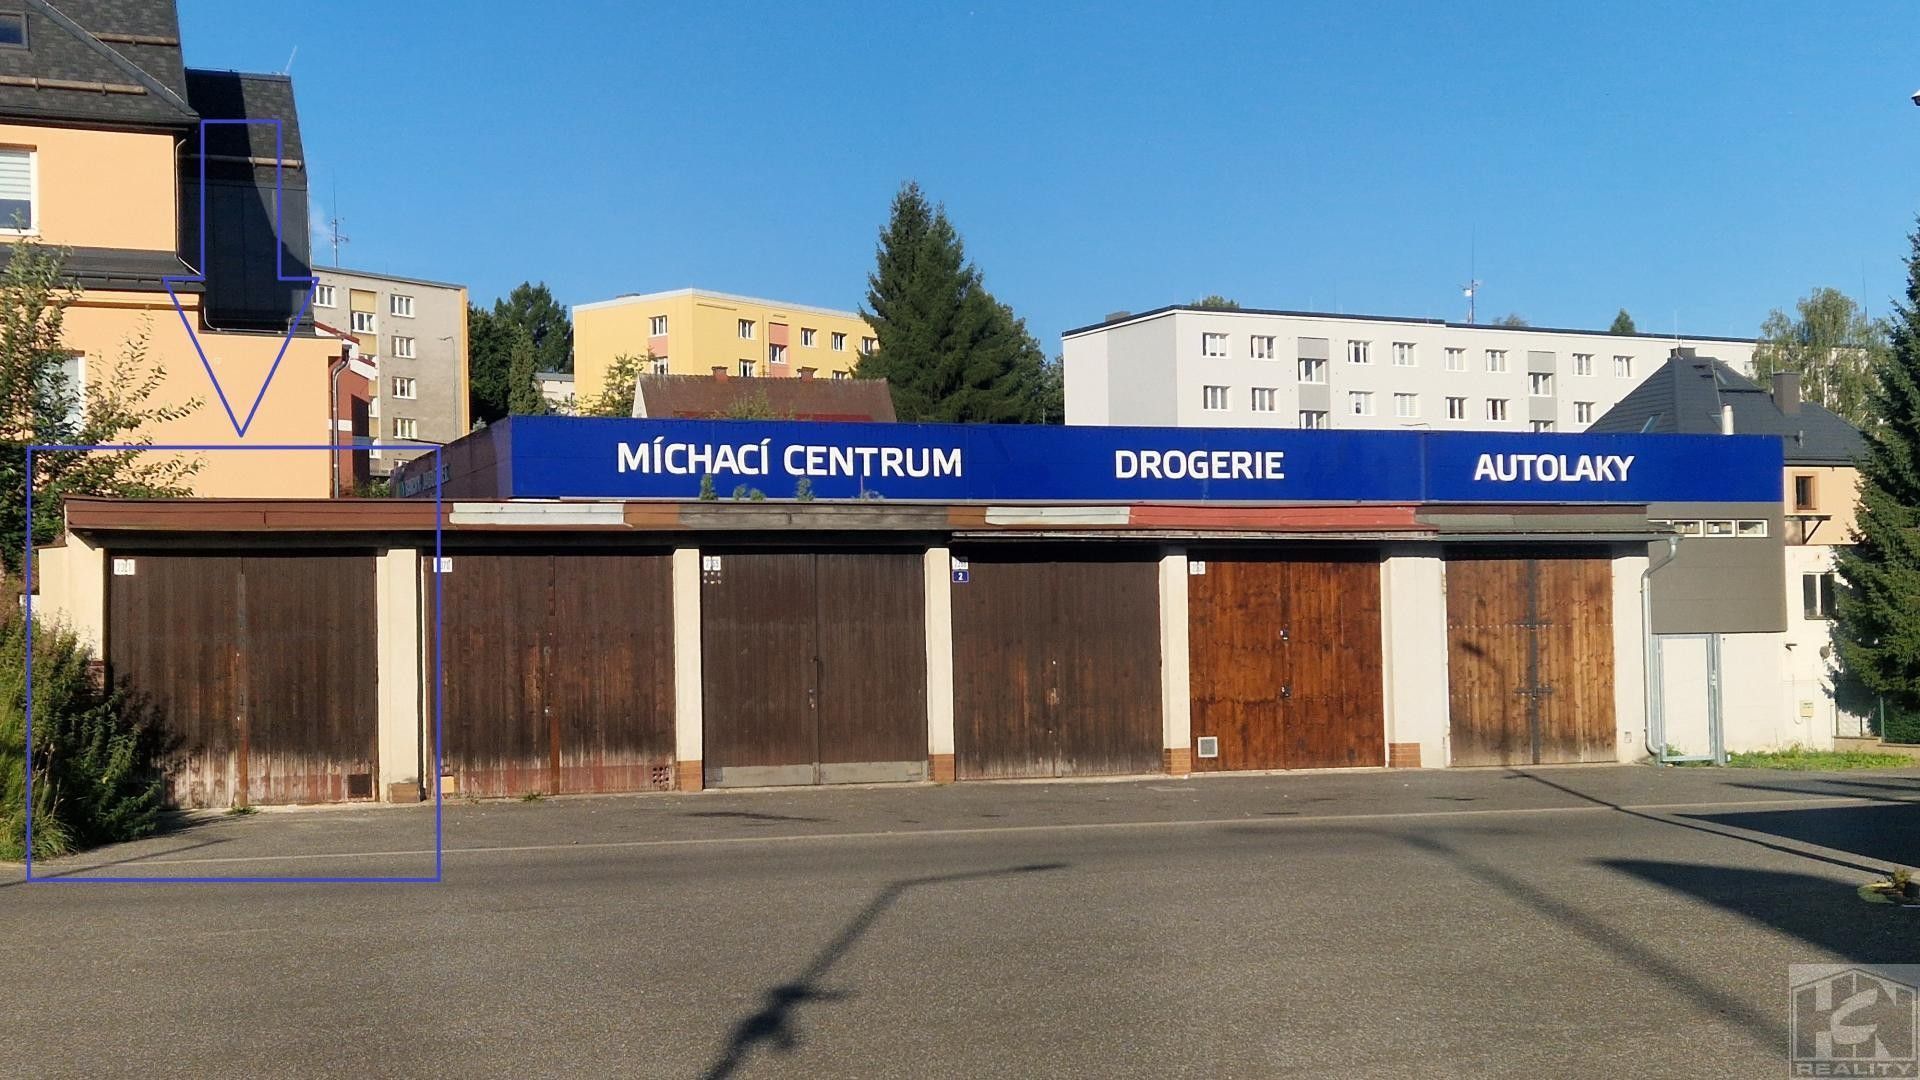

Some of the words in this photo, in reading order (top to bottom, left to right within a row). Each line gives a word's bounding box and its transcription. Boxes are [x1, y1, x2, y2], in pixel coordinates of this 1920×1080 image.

[617, 437, 772, 475] MÍCHACÍ
[784, 445, 962, 477] CENTRUM
[1115, 450, 1285, 480] DROGERIE
[1473, 453, 1635, 483] AUTOLAKY
[958, 572, 964, 581] 2
